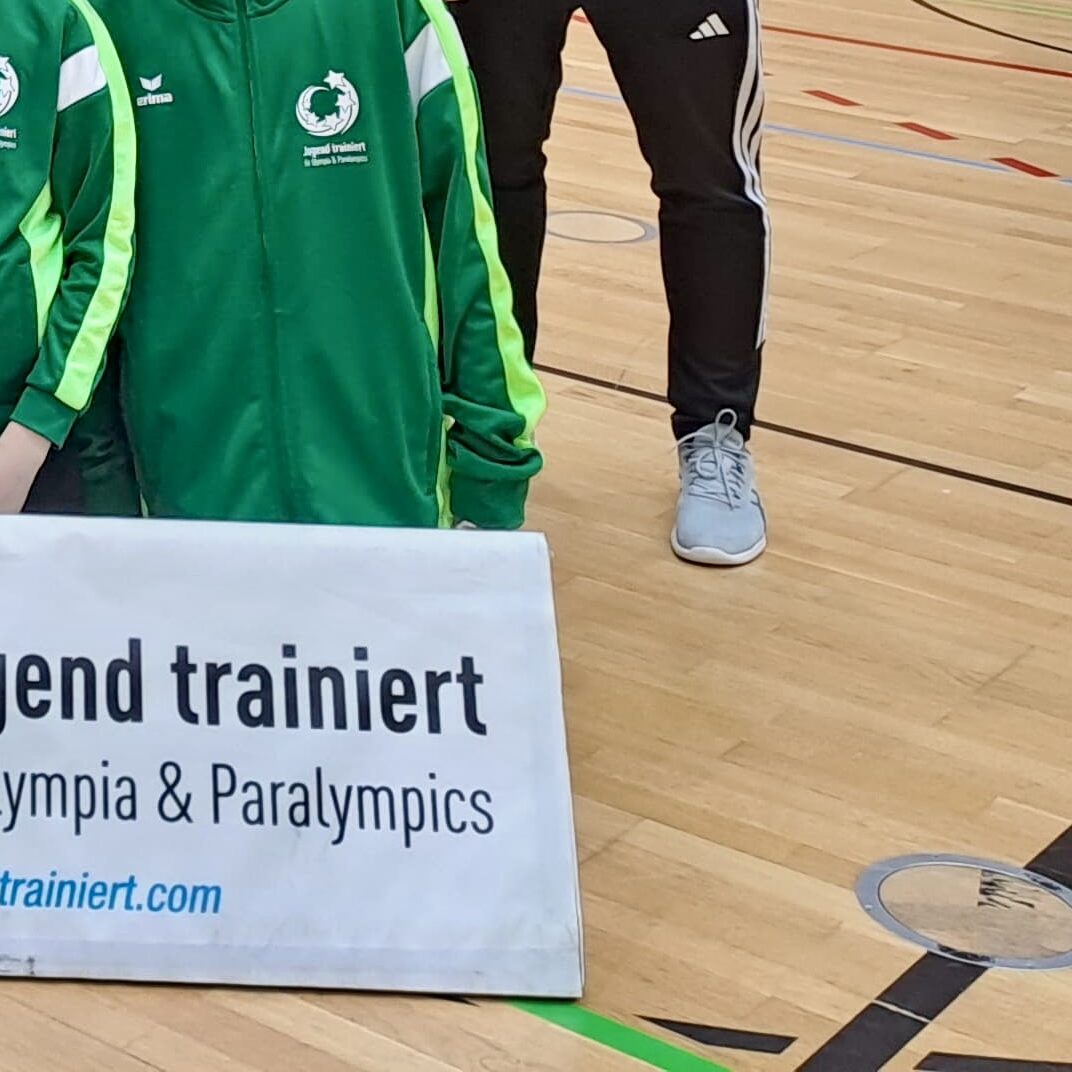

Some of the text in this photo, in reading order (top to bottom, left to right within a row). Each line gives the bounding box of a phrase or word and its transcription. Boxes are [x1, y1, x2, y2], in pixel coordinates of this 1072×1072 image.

[136, 92, 173, 107] erima
[171, 643, 488, 736] trainiert
[157, 760, 194, 825] &
[211, 763, 495, 849] Paralympics
